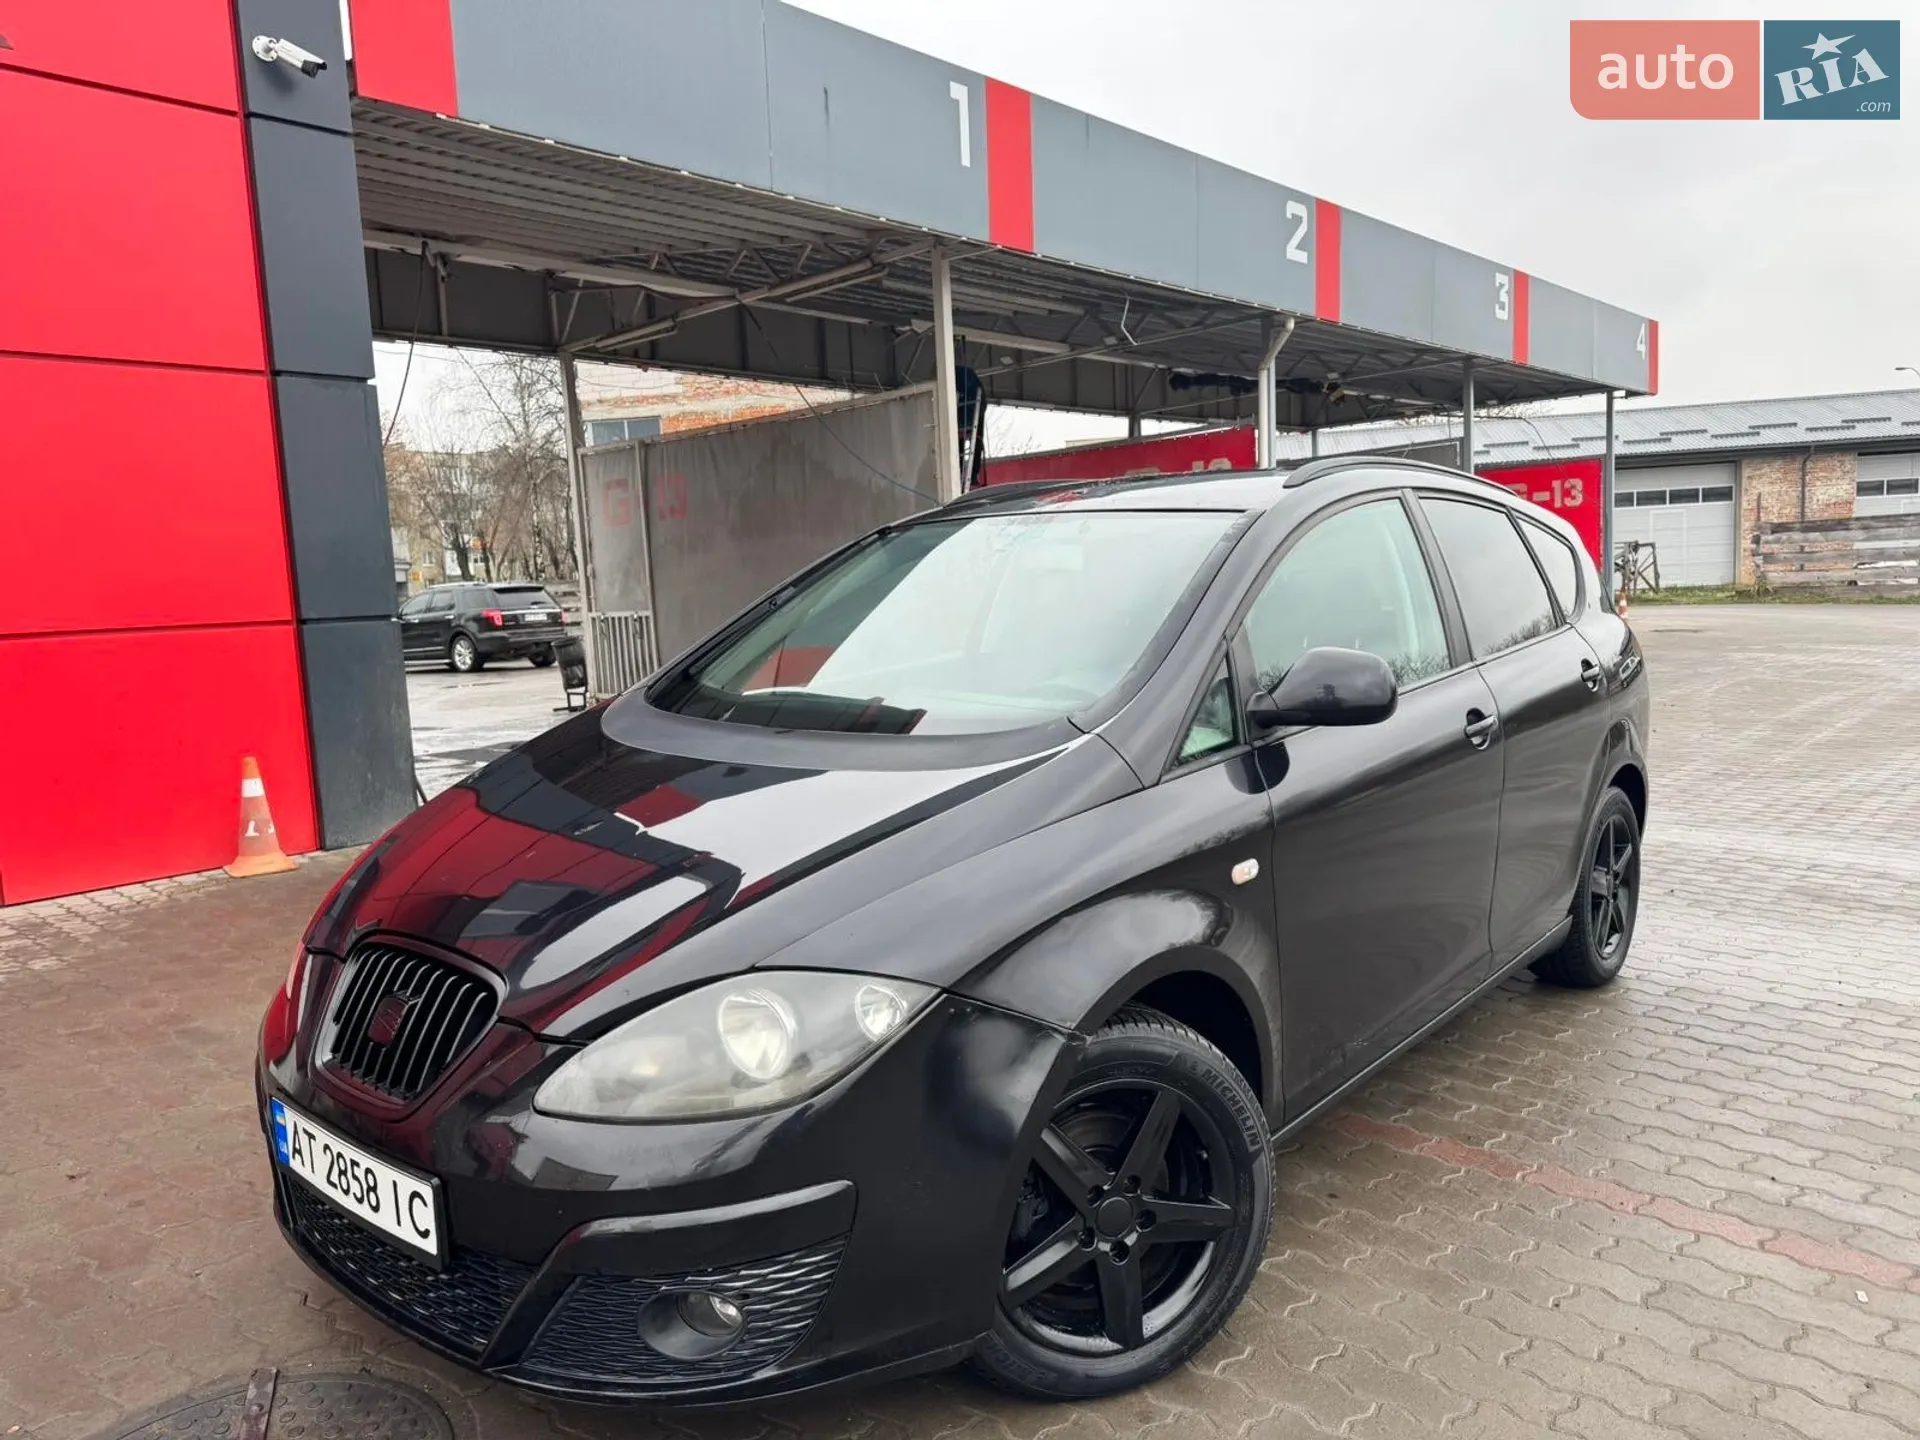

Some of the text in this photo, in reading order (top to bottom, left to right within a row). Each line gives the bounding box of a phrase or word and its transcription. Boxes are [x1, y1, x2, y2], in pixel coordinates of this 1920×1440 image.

[949, 80, 971, 168] 1
[1285, 199, 1308, 264] 2
[1494, 272, 1509, 321] 3
[1636, 322, 1647, 360] 4
[291, 1120, 431, 1240] AT 2858 IC
